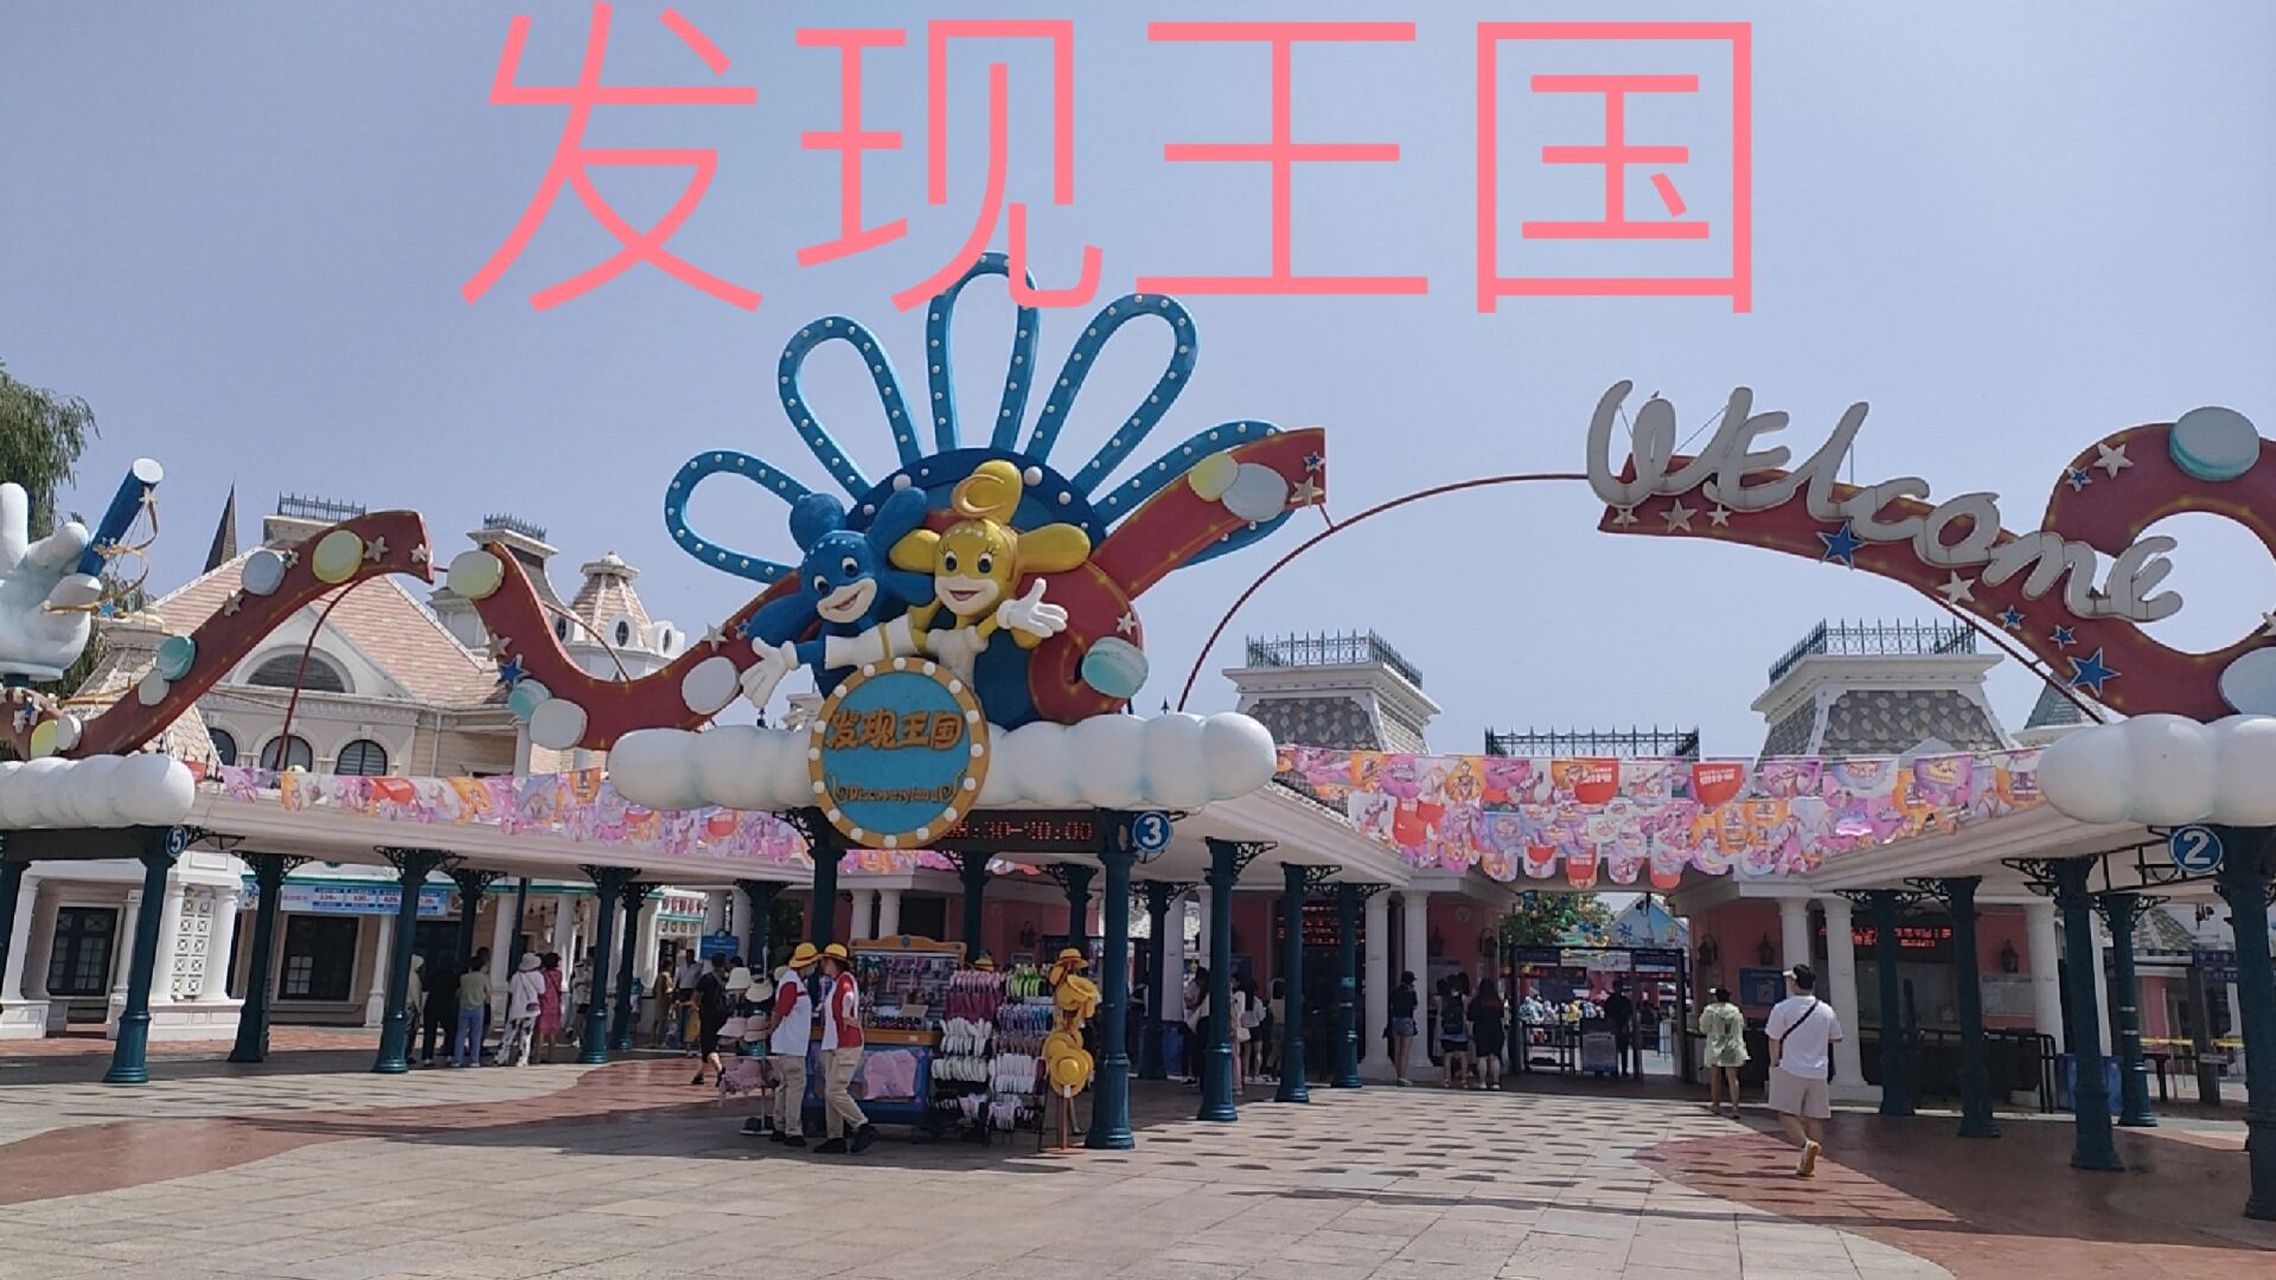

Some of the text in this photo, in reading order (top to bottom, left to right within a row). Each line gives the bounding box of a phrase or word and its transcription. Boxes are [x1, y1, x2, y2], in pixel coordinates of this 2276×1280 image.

[827, 708, 962, 749] 发现王国
[170, 830, 184, 853] 5
[1142, 818, 1163, 845] 3
[2184, 830, 2211, 865] 2
